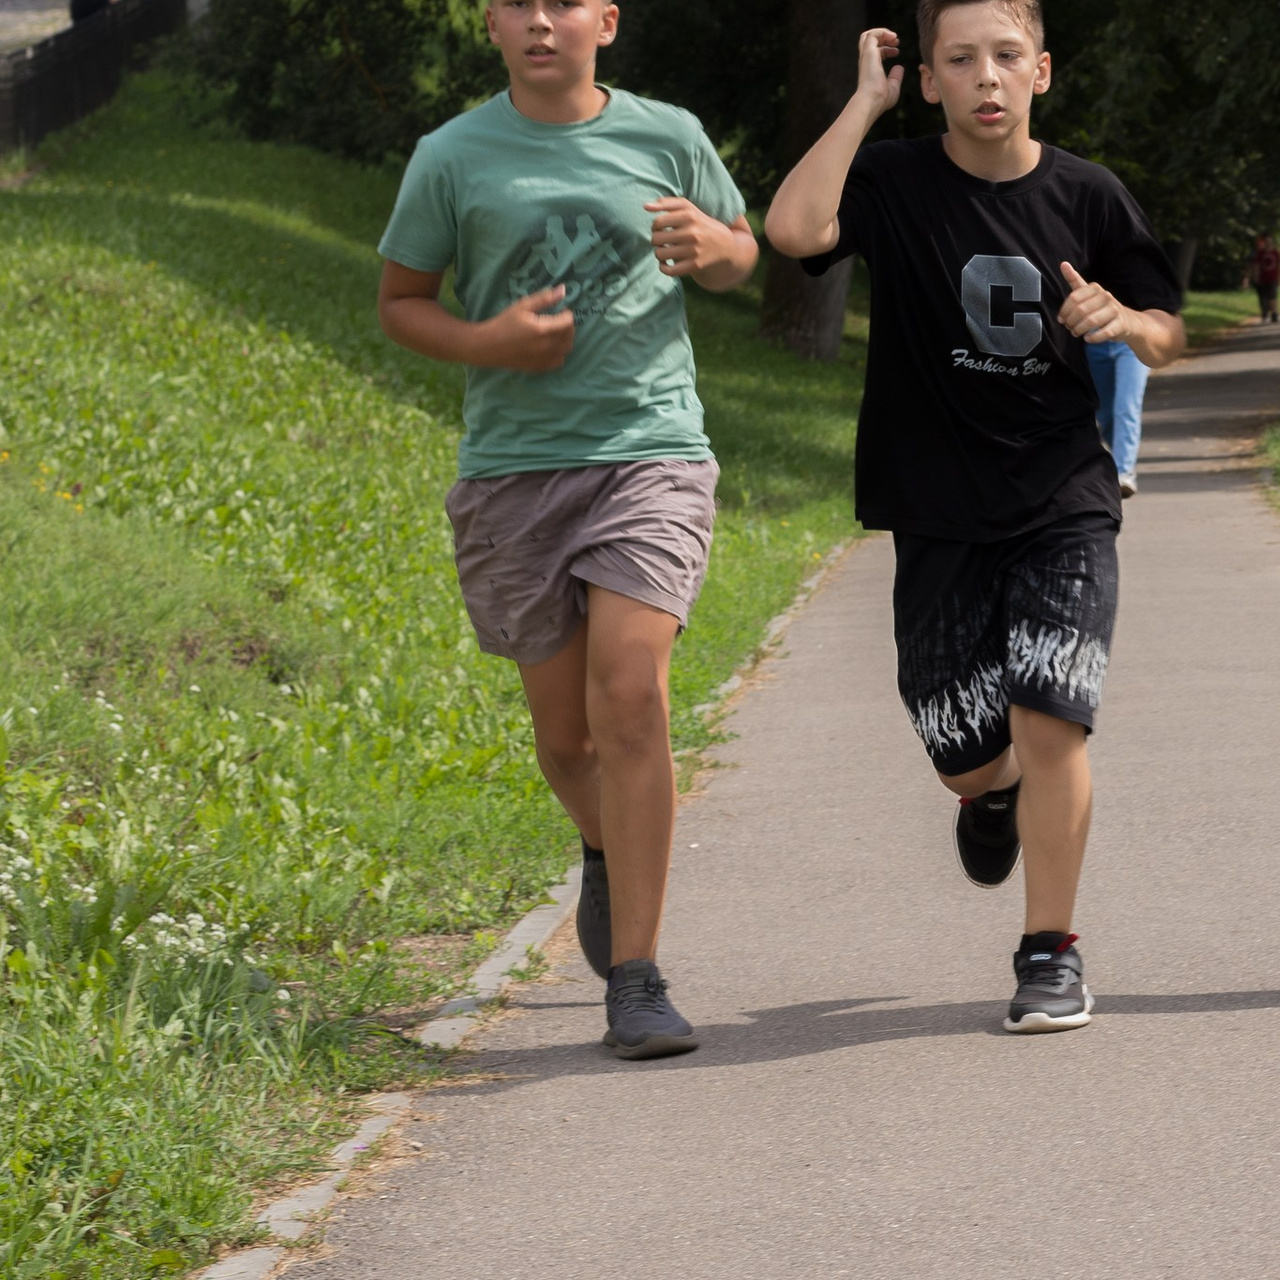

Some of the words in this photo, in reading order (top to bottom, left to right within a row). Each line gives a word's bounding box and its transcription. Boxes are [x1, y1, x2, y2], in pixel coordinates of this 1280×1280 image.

[962, 255, 1042, 355] C
[951, 349, 1018, 376] Fashion
[1022, 358, 1051, 375] Boy
